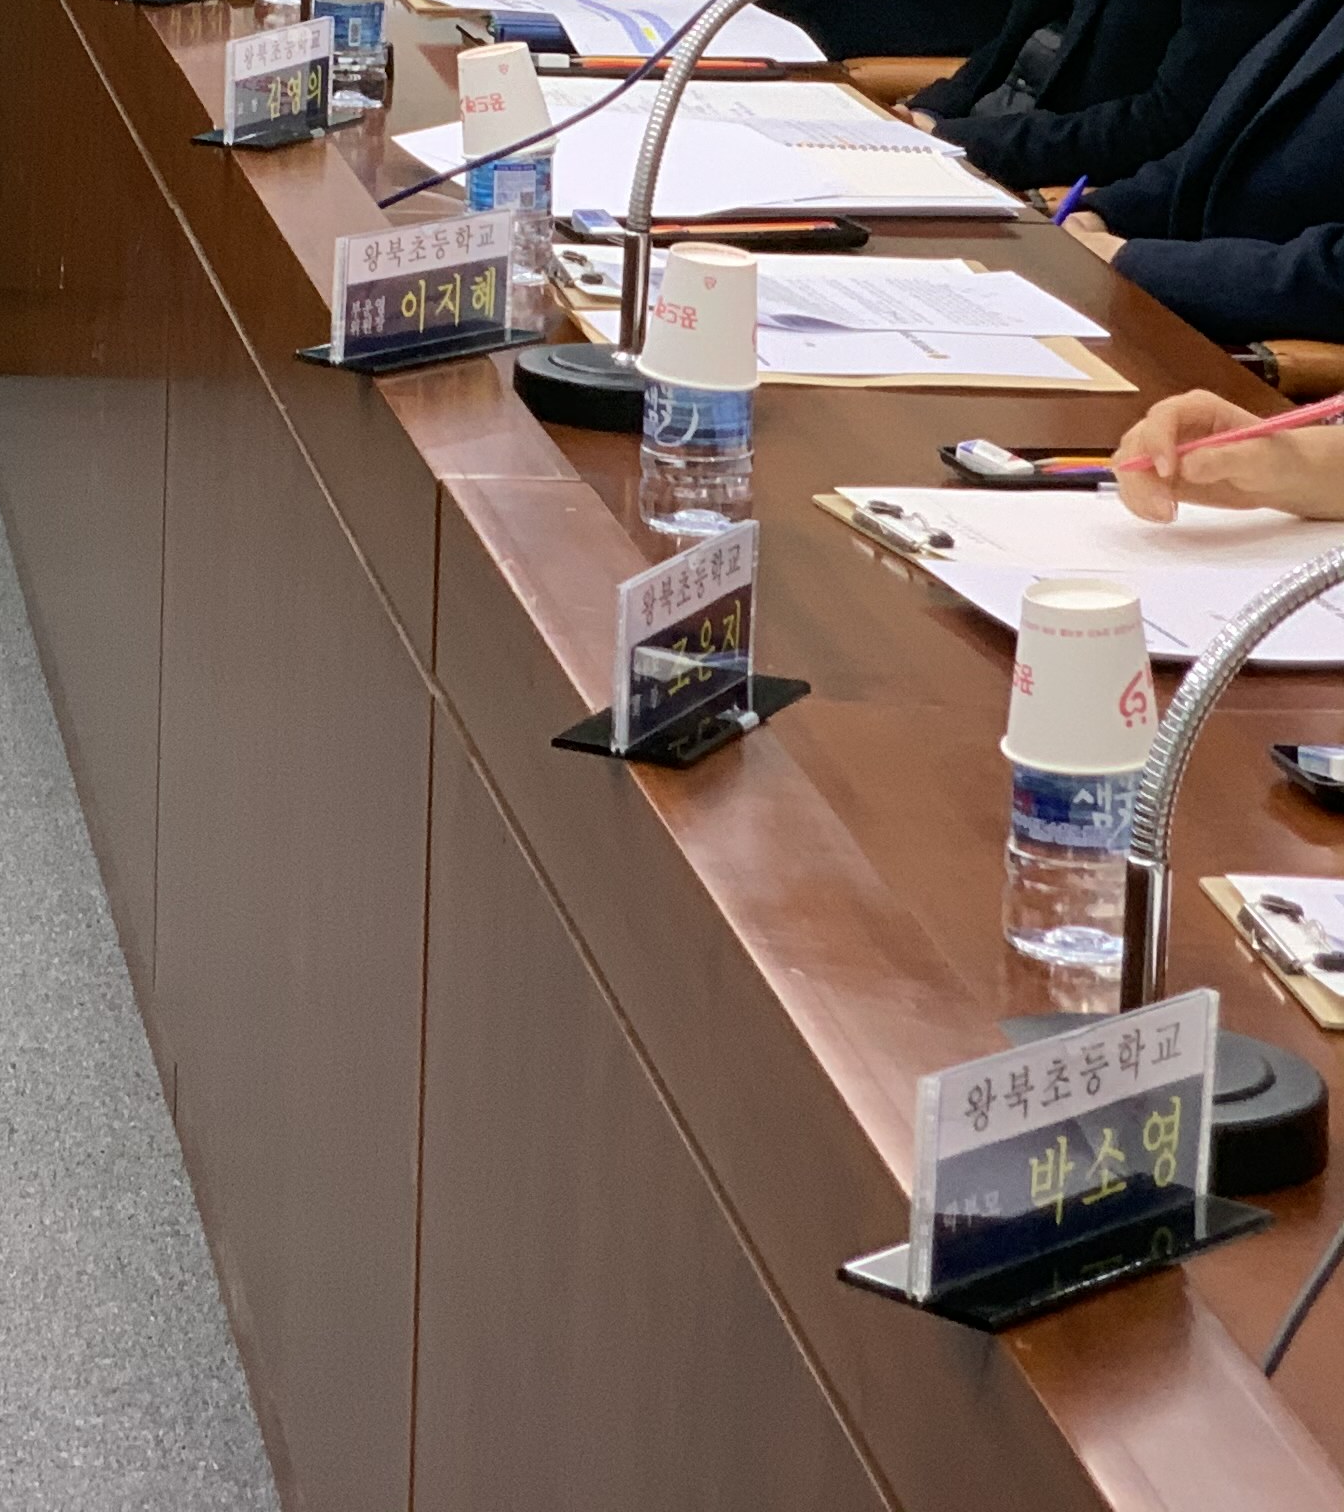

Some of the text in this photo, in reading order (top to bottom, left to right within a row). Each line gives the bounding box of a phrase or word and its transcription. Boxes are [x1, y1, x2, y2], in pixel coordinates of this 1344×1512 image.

[267, 64, 322, 121] 김영의
[363, 221, 496, 273] 왕북초등학교
[400, 265, 496, 334] 이지혜
[640, 542, 742, 627] 왕북초등학교
[964, 1019, 1183, 1133] 왕북초등학교
[1028, 1094, 1181, 1226] 박소영
